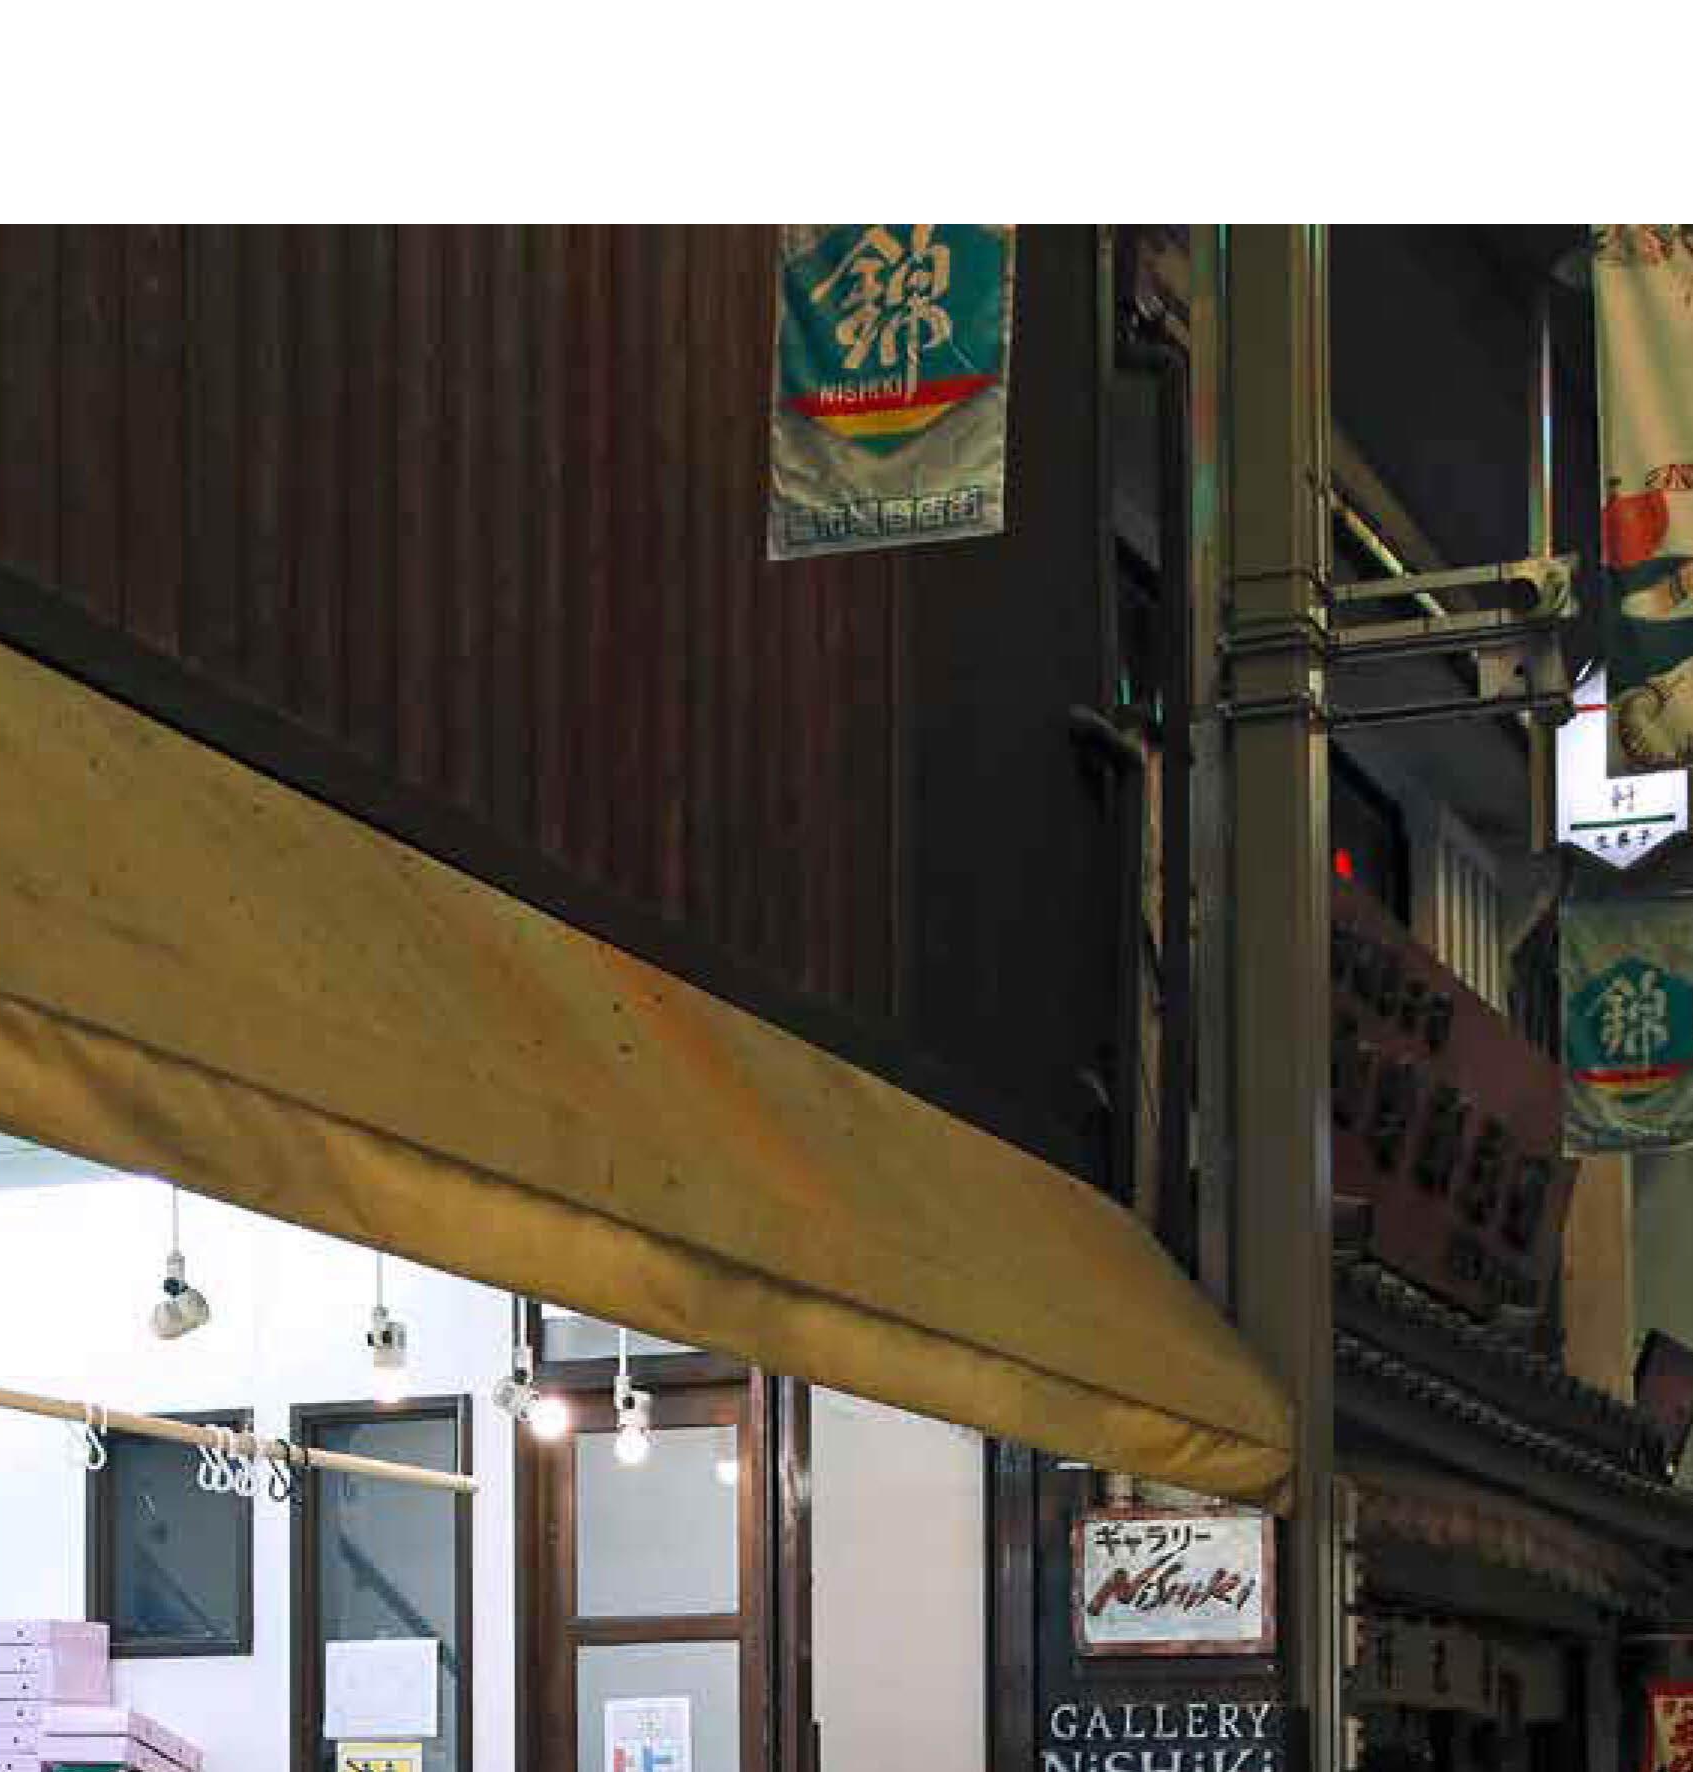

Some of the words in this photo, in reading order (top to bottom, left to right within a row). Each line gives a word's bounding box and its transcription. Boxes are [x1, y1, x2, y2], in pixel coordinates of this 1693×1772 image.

[1093, 1524, 1212, 1557] ギャラリー
[1049, 1702, 1271, 1740] GALLERY
